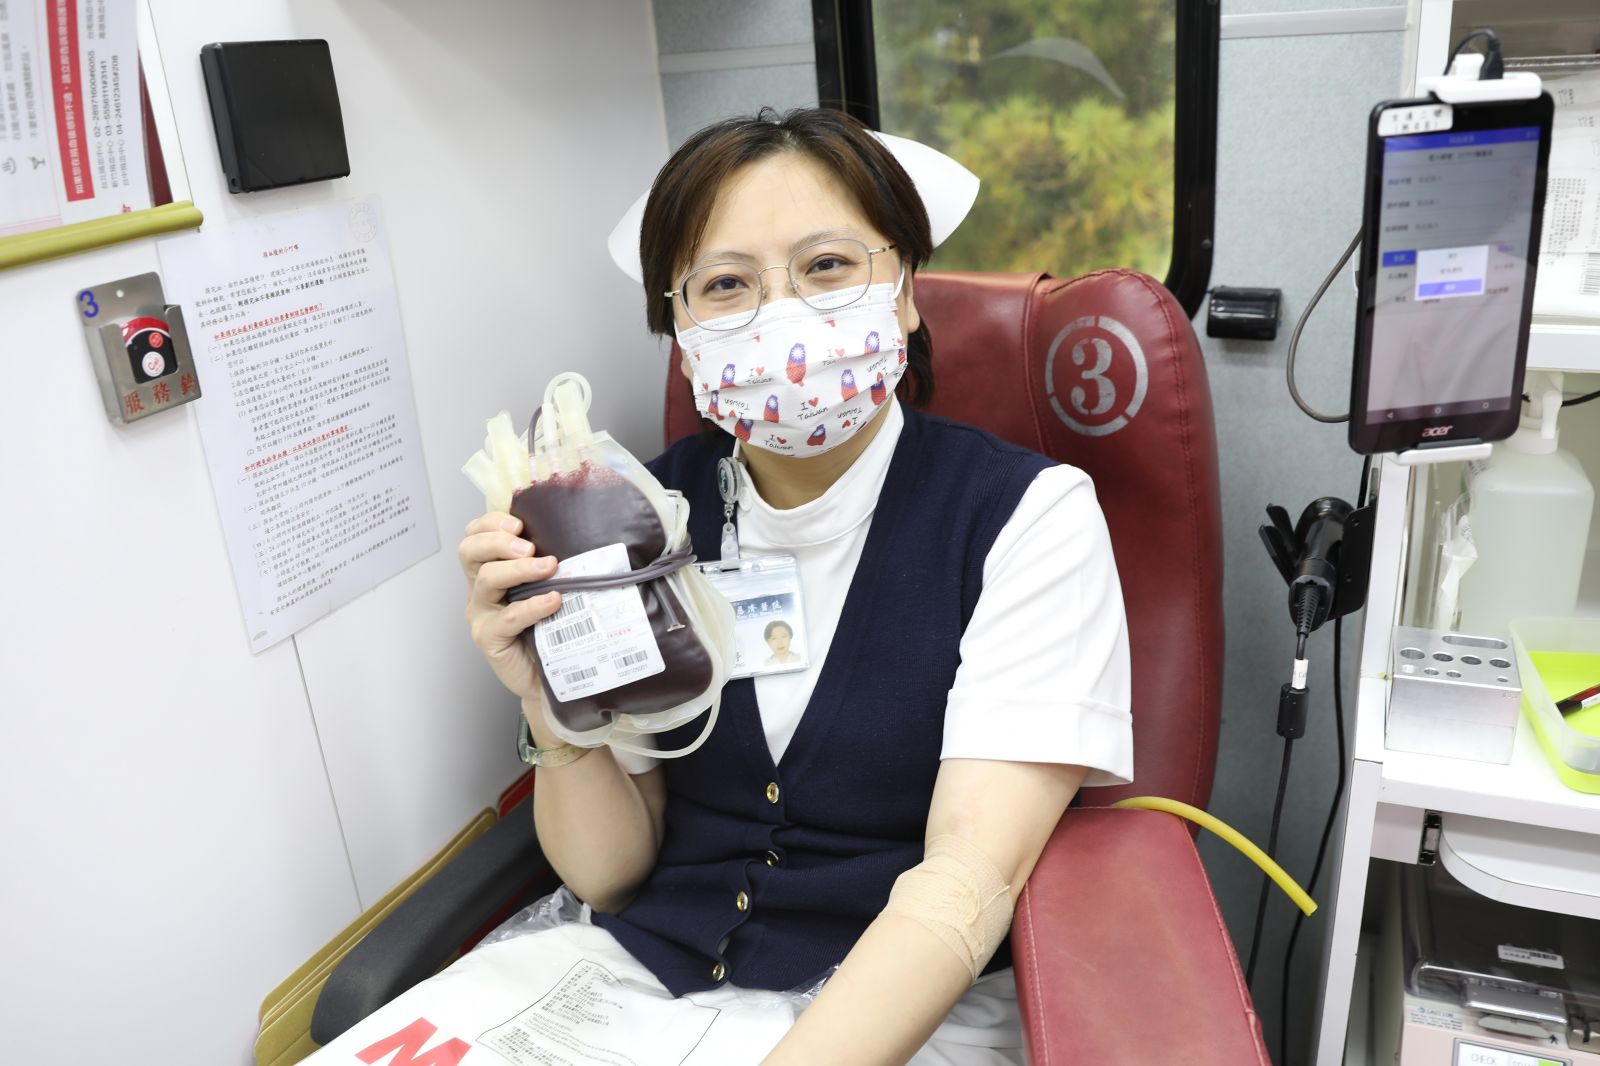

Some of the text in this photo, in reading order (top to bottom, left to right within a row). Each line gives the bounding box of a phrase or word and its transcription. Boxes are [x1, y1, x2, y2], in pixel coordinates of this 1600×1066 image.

[79, 289, 100, 319] 3
[745, 377, 773, 385] Taiwan
[1071, 338, 1117, 416] 3
[122, 373, 198, 416] 服務鈴
[797, 406, 829, 421] Taiwan
[837, 407, 863, 419] Taiwan
[1422, 425, 1453, 437] acer
[764, 440, 794, 450] Taiwan
